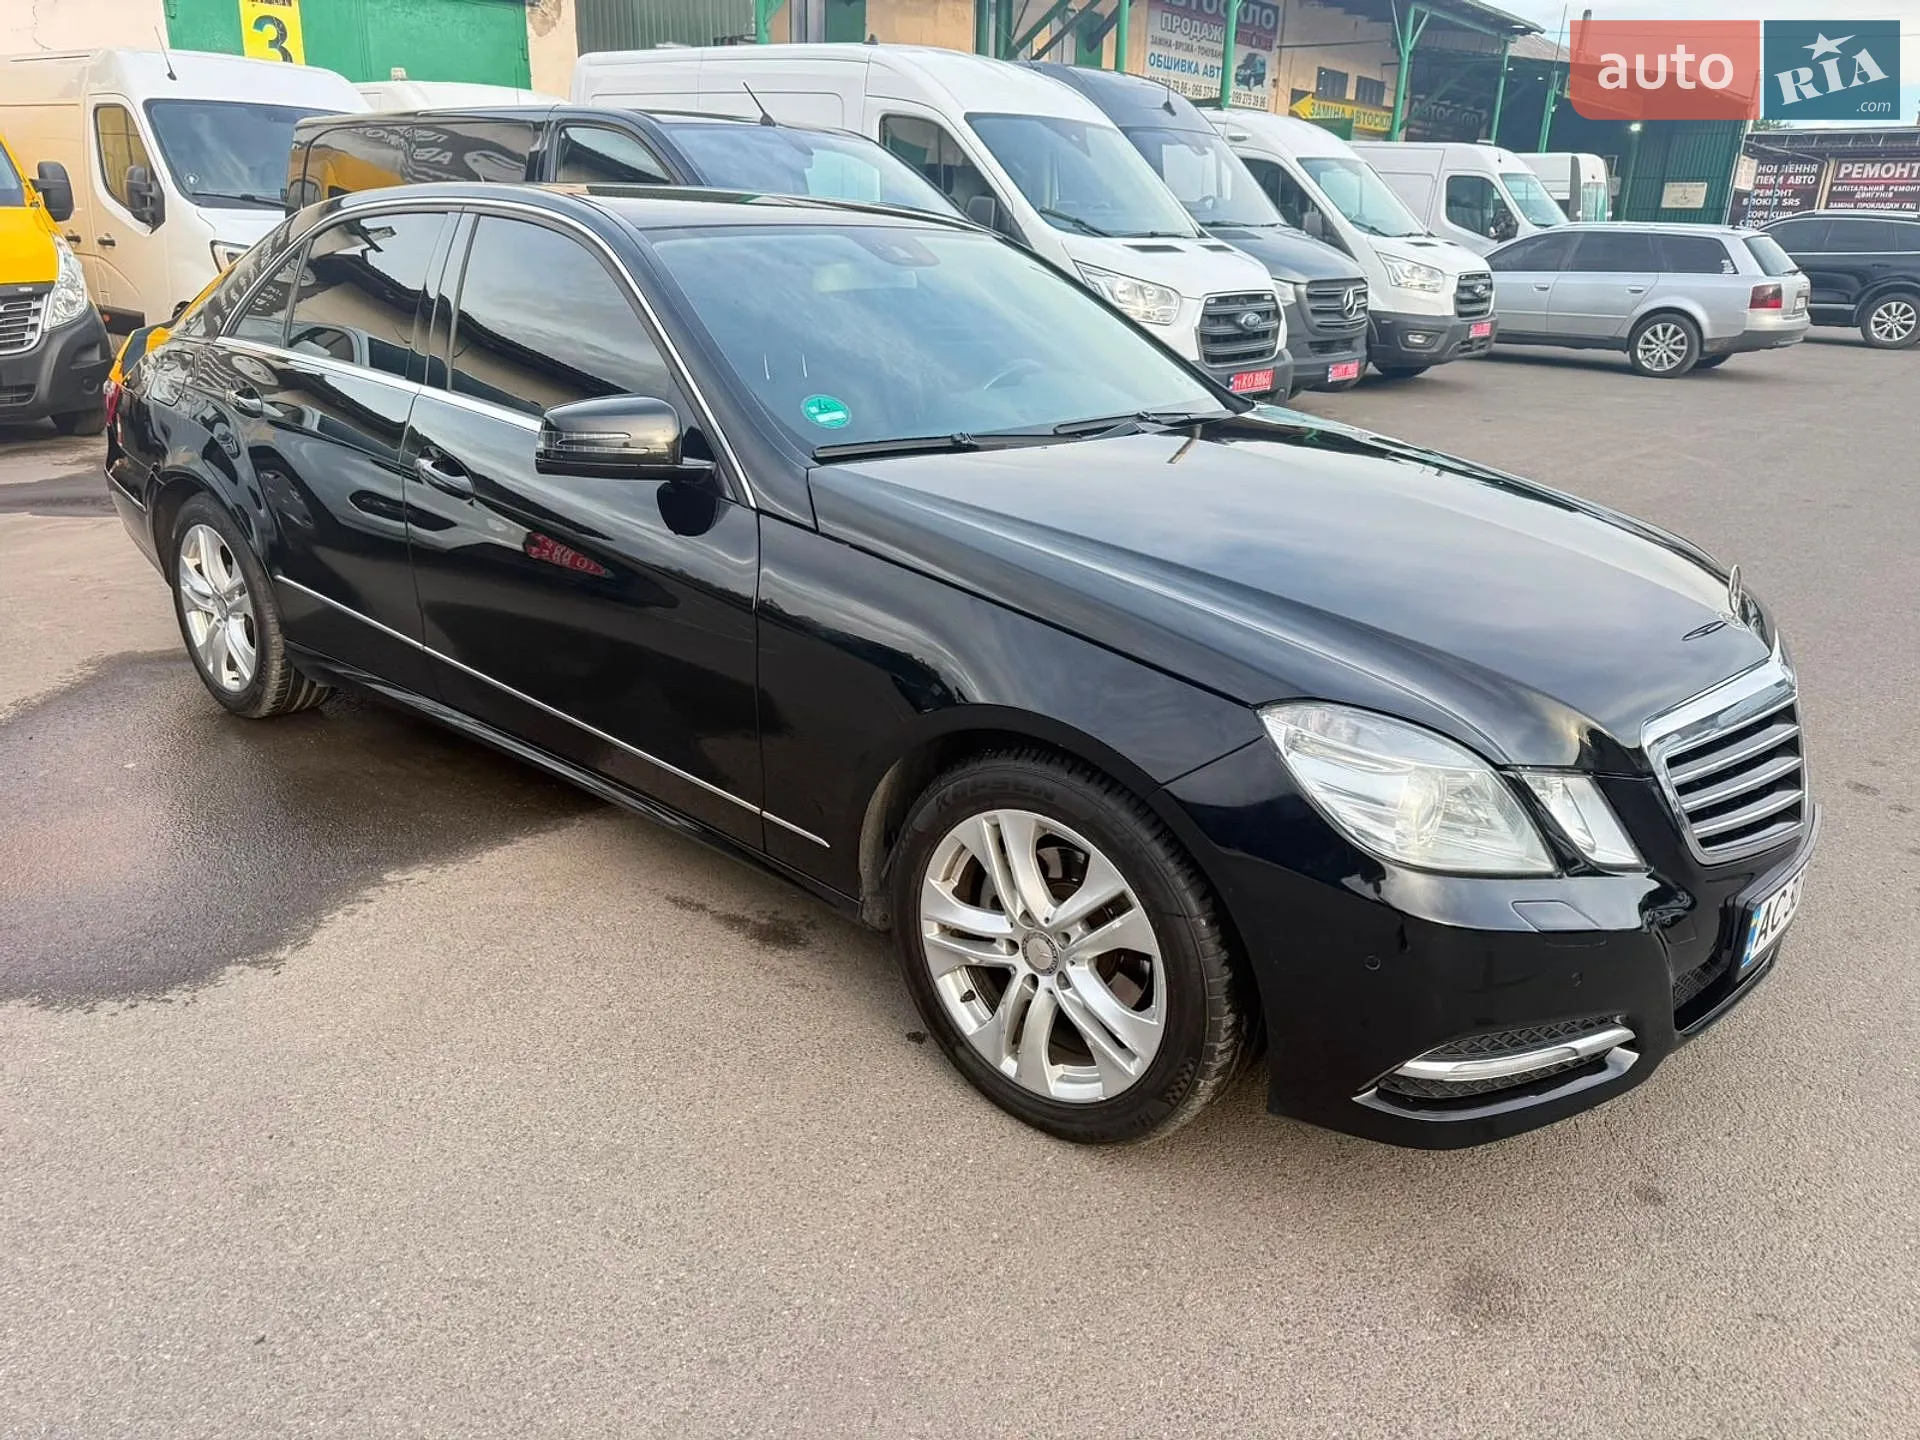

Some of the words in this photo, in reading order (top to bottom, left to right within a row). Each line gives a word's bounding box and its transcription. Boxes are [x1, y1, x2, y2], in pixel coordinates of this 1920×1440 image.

[252, 14, 294, 63] 3
[1149, 52, 1199, 75] ОБШИВКА
[1202, 63, 1222, 80] АВТ
[1838, 162, 1920, 179] РЕМОНТ
[1786, 175, 1816, 185] АВТО
[1754, 189, 1795, 198] РЕМОНТ
[1781, 198, 1801, 207] SRS
